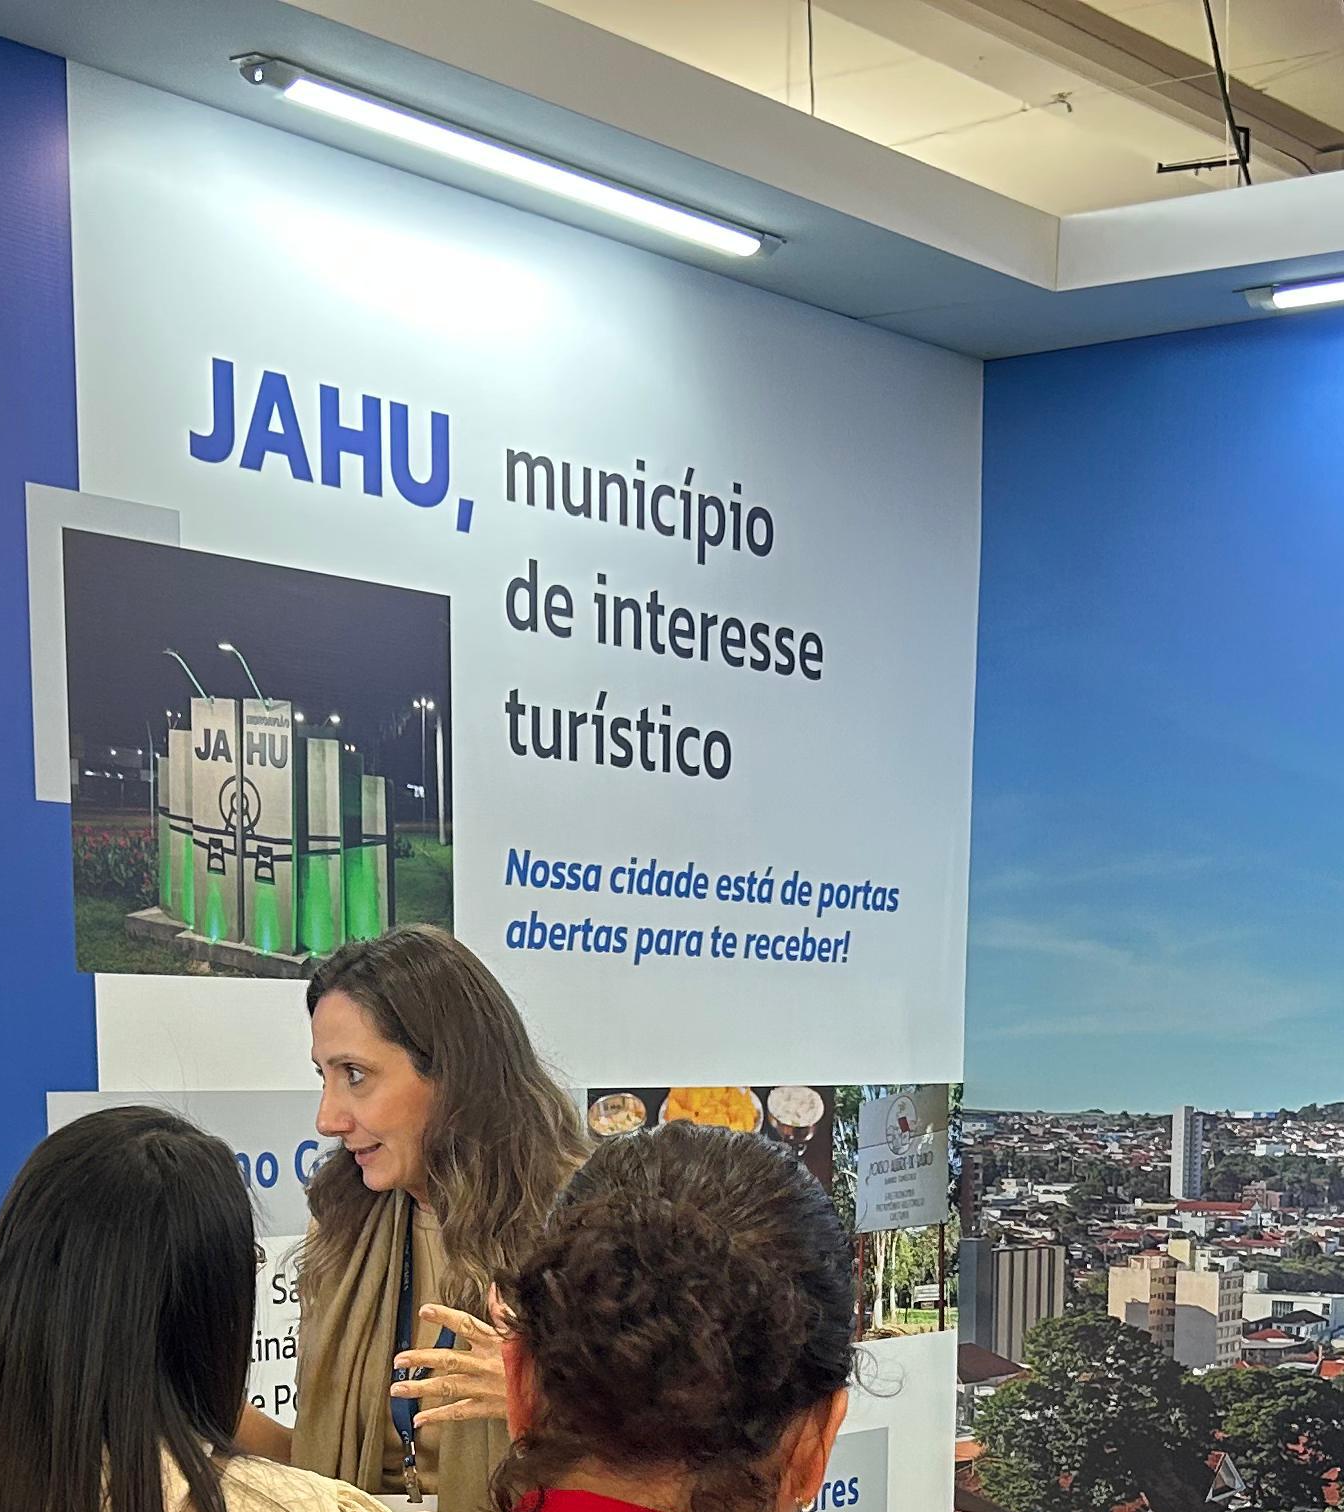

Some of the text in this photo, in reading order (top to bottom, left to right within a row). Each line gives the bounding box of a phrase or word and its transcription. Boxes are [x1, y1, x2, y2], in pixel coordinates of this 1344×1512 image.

[189, 357, 774, 565] JAHU, município
[506, 558, 824, 681] de interesse
[194, 728, 289, 769] JA HU
[506, 688, 732, 781] turístico
[504, 847, 900, 918] Nossa cidade está de portas
[505, 910, 851, 965] abertas para te receber!
